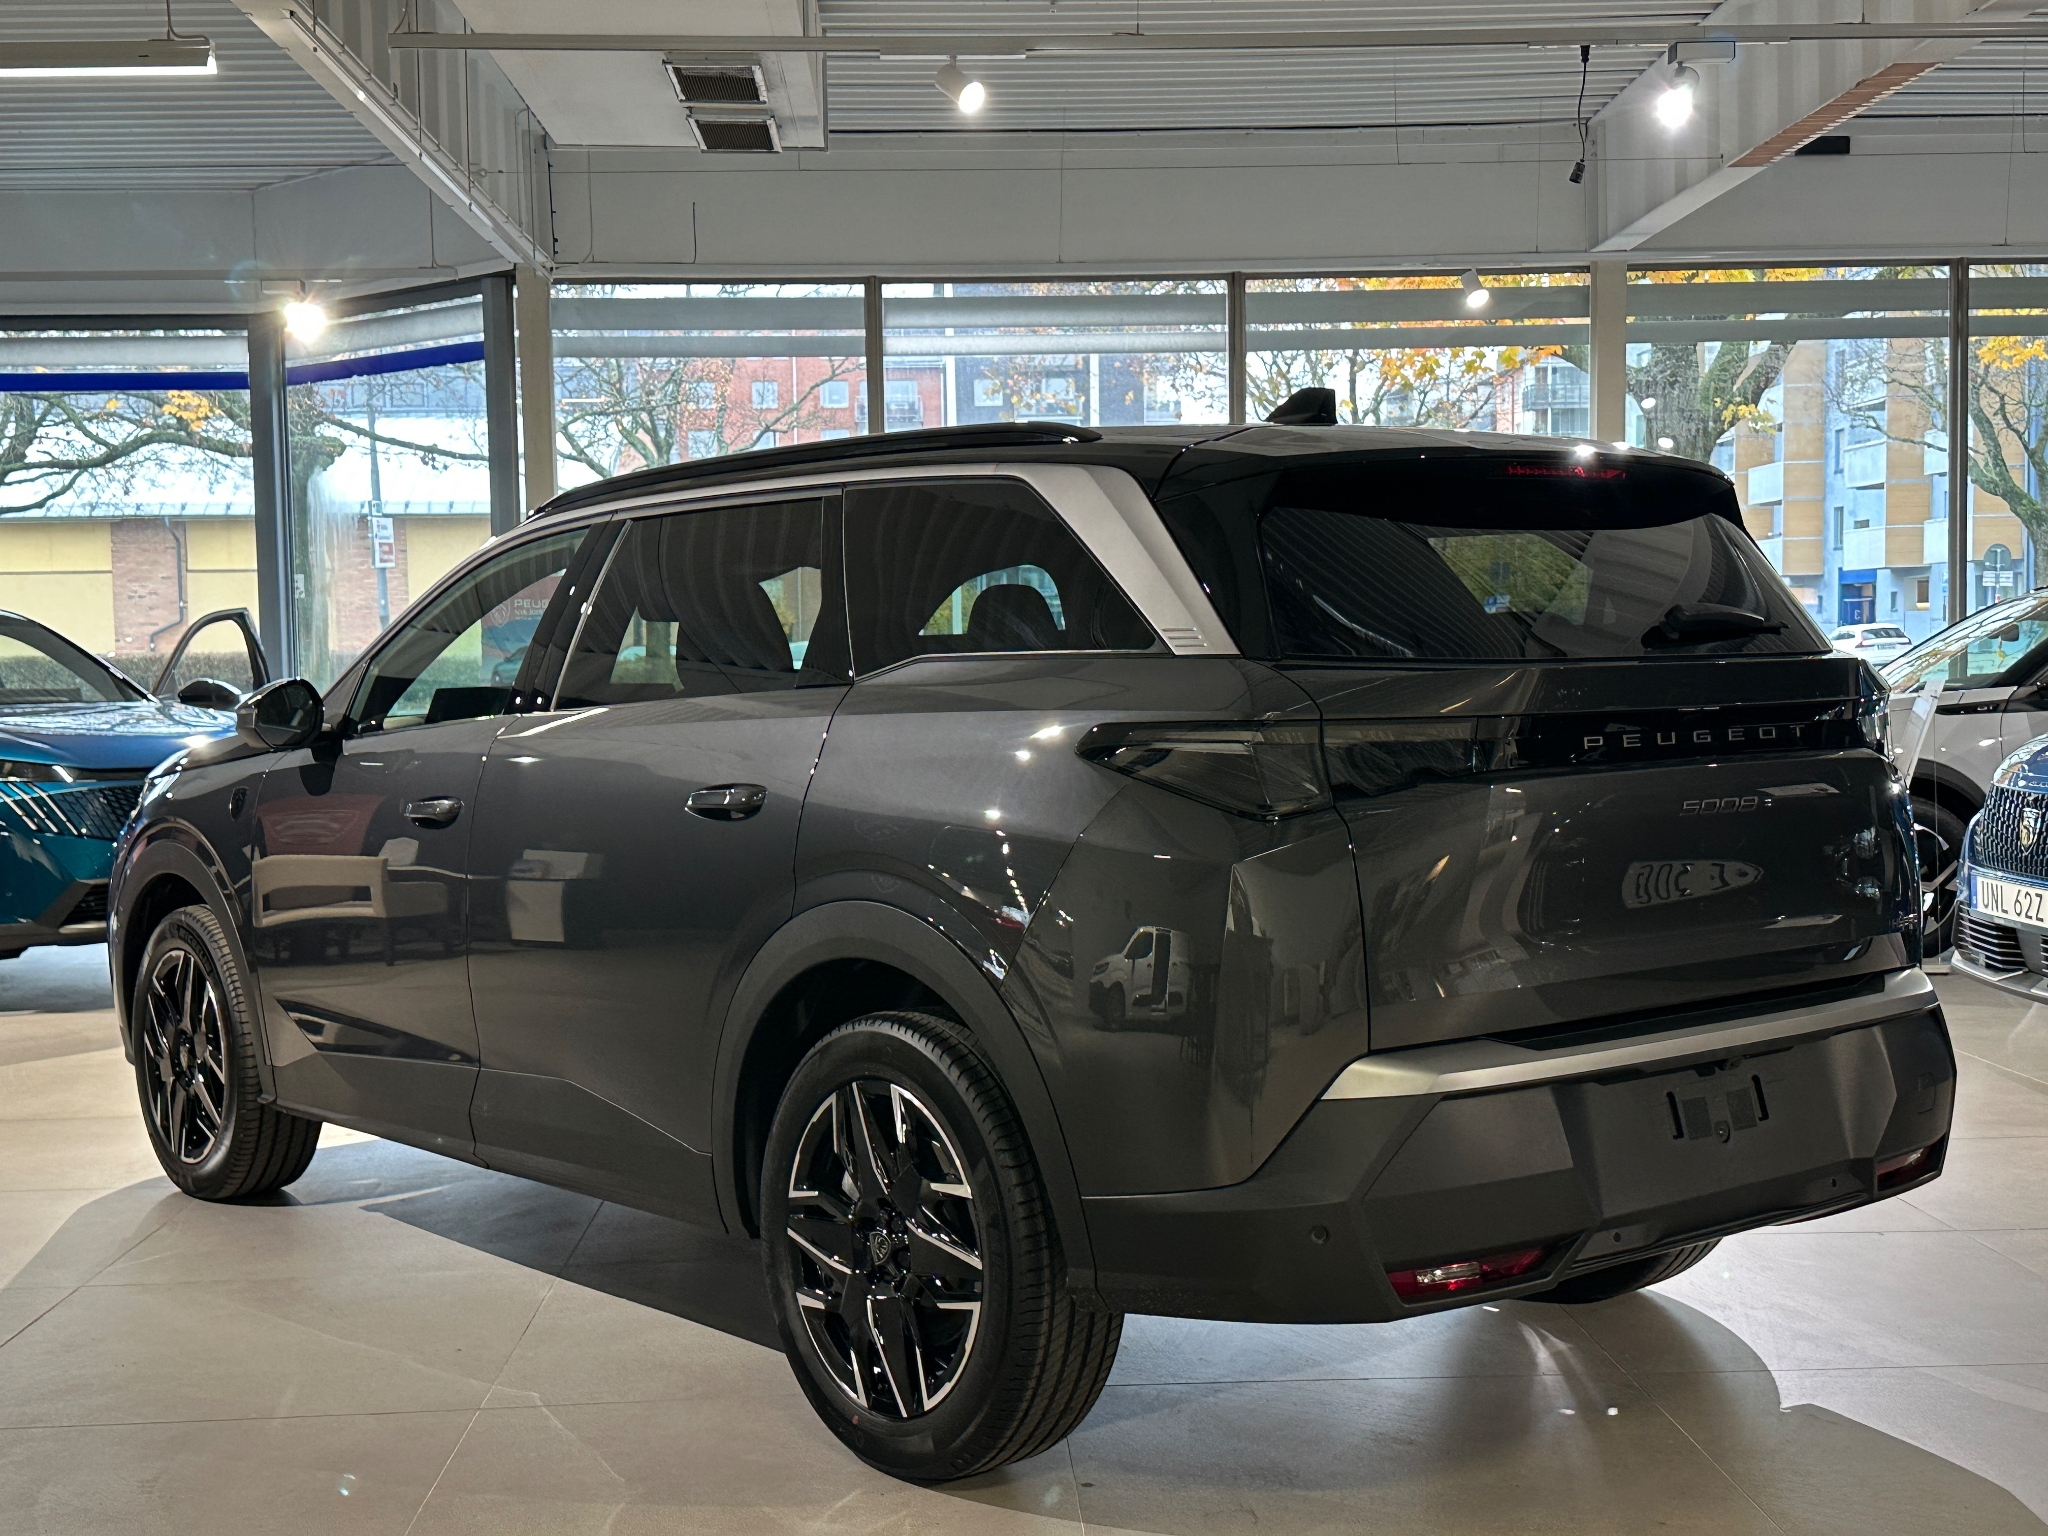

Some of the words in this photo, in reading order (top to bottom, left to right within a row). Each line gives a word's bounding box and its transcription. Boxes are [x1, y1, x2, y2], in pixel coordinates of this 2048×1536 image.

[1584, 725, 1805, 749] PEUGEOT
[1681, 796, 1759, 816] 5008
[1981, 880, 2009, 915] UNL
[2013, 889, 2044, 923] 62Z
